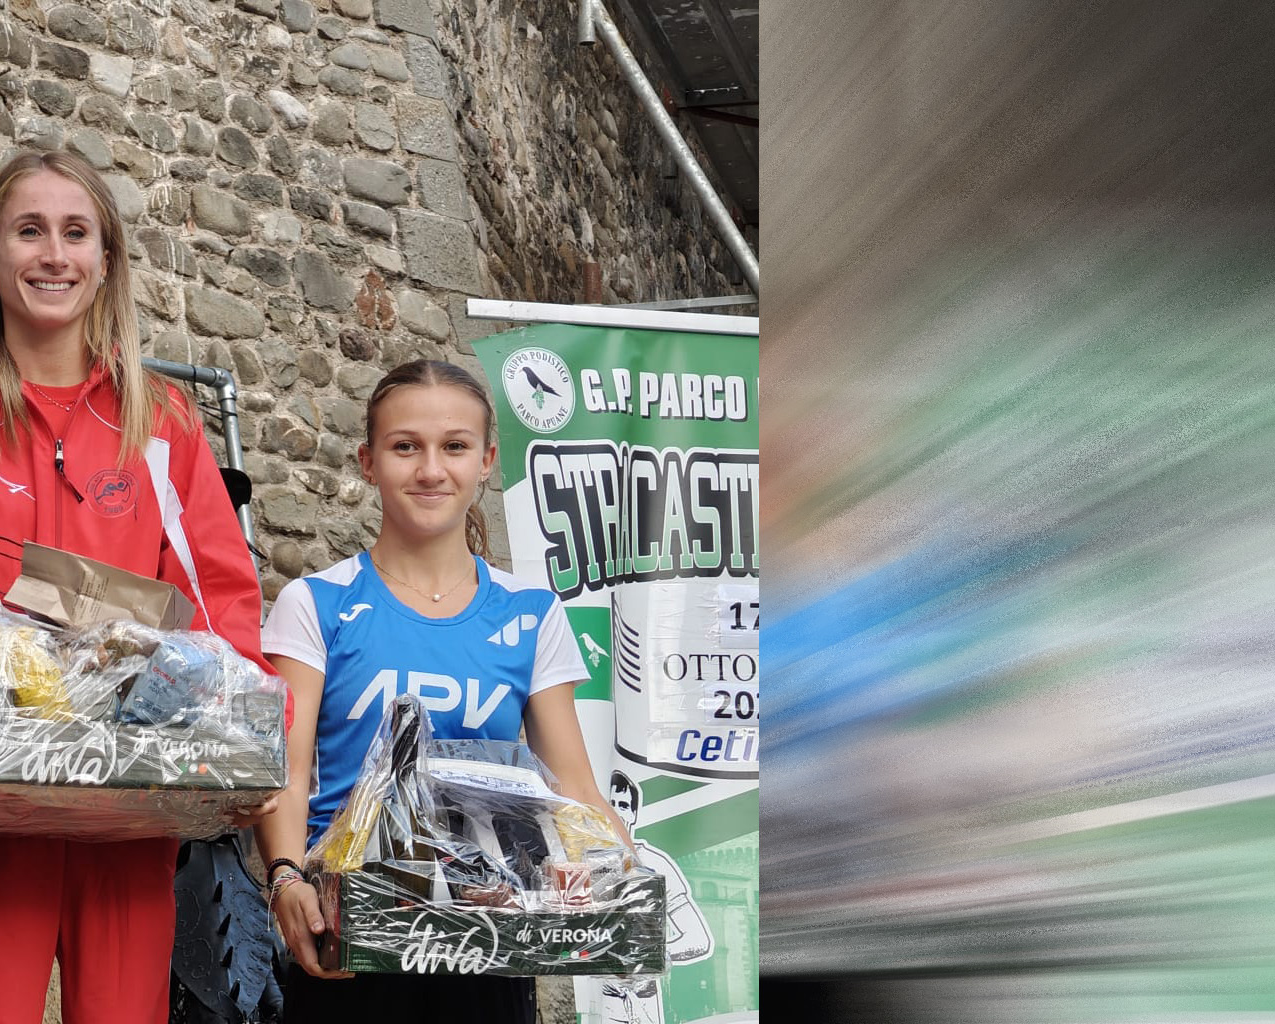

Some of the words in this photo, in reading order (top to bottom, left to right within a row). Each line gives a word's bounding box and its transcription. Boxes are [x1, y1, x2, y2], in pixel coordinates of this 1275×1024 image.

[505, 353, 529, 380] GRUPPO
[529, 351, 569, 383] PODISTICO
[580, 368, 633, 414] G.P.
[639, 371, 747, 421] PARCO
[517, 403, 540, 427] PARCO
[541, 406, 569, 428] APUANE
[663, 654, 759, 681] OTTO
[714, 690, 759, 720] 20
[676, 729, 759, 762] Ceti
[539, 928, 613, 943] VERONA
